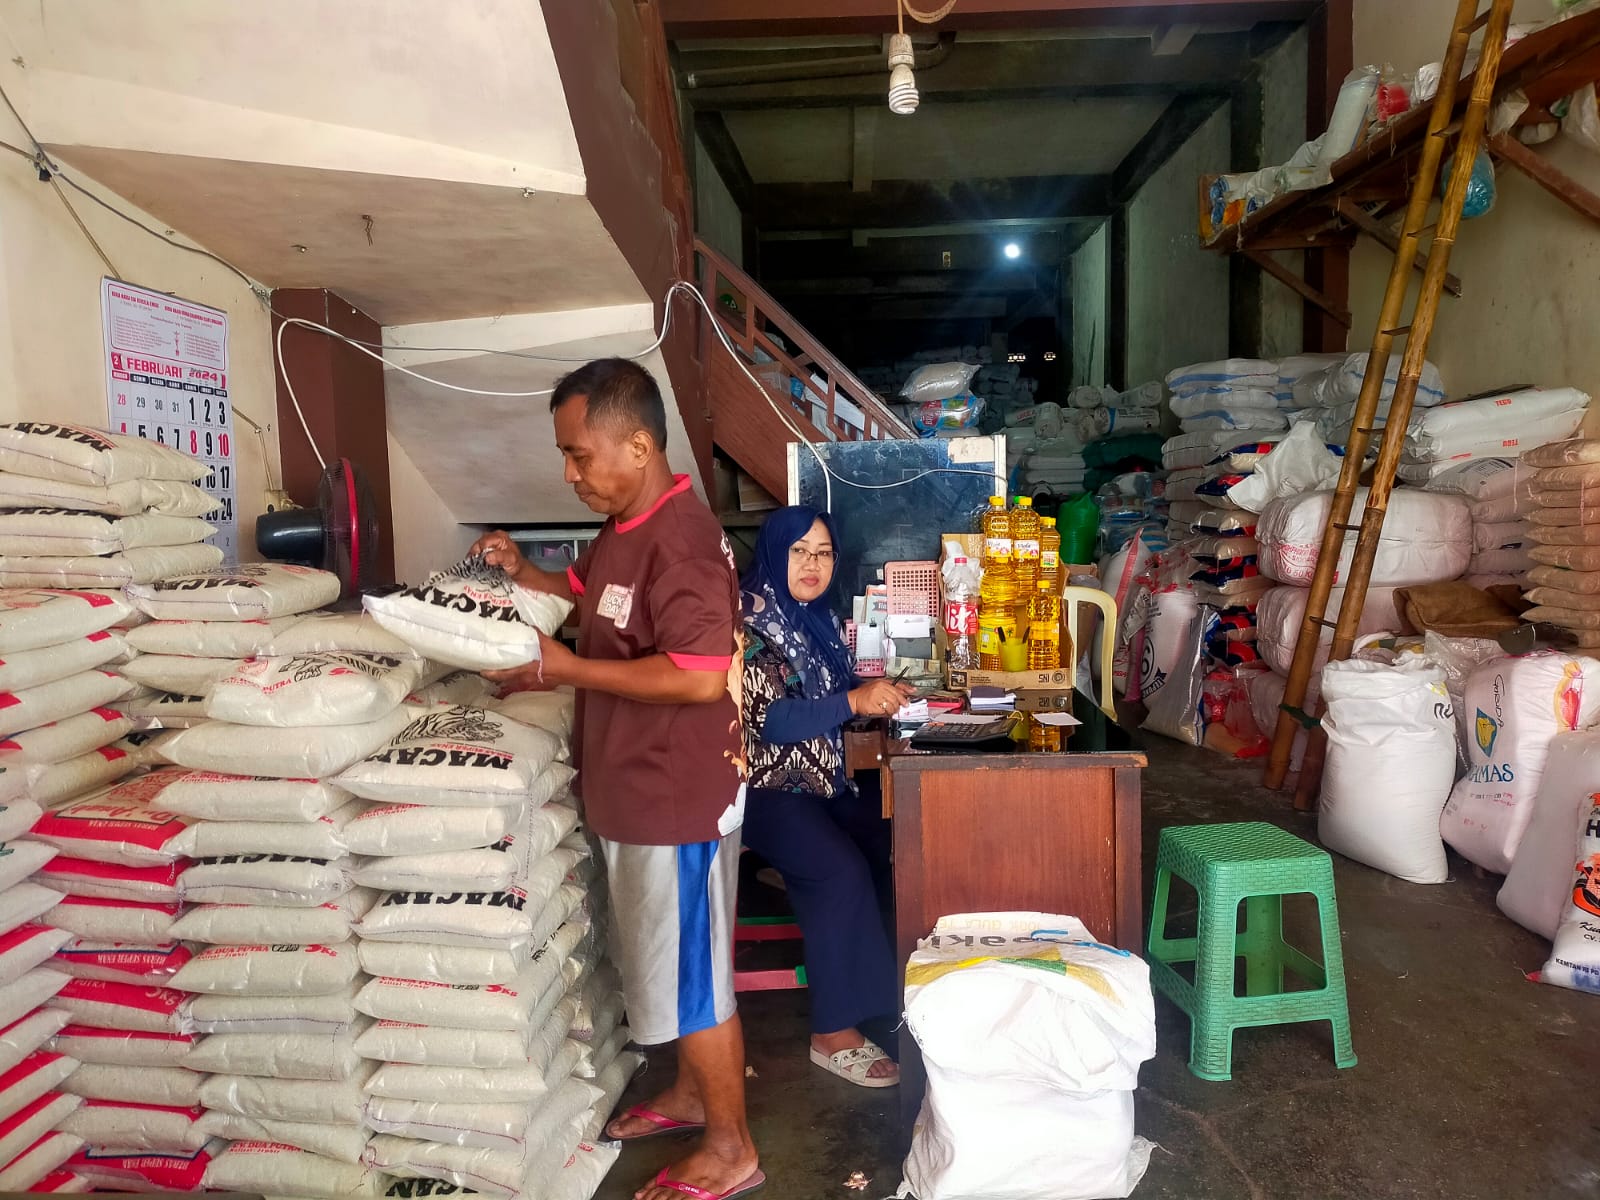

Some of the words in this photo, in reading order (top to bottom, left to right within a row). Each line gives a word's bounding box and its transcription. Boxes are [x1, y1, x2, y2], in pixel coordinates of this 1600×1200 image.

[127, 358, 182, 378] FEBRUARI
[189, 370, 218, 381] 2024
[117, 393, 126, 405] 28
[136, 396, 146, 408] 29
[154, 399, 163, 410] 30
[172, 402, 180, 413] 31
[189, 396, 195, 421] 1
[204, 398, 211, 423] 2
[218, 401, 226, 425] 3
[156, 426, 165, 444] 6
[173, 428, 180, 450] 7
[190, 430, 198, 454] 8
[205, 431, 213, 456] 9
[218, 432, 230, 457] 10
[220, 466, 230, 489] 17
[221, 498, 232, 521] 24
